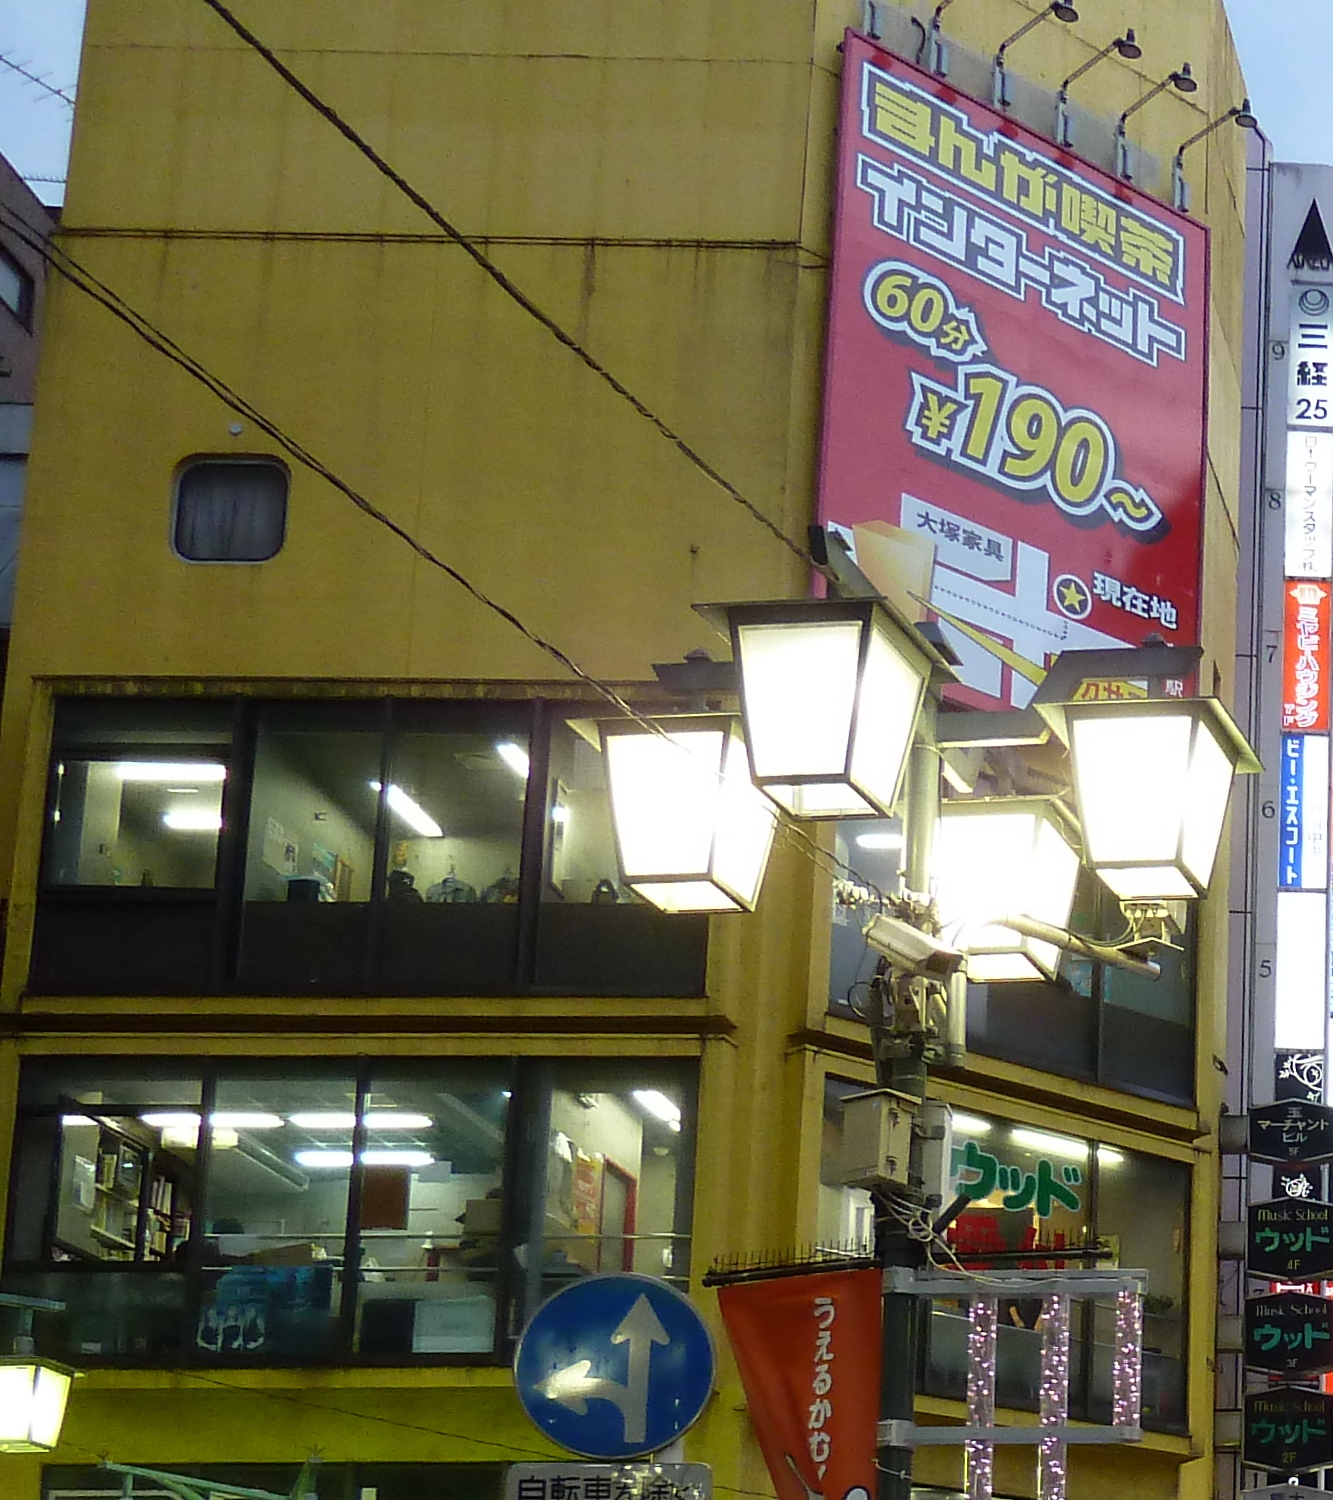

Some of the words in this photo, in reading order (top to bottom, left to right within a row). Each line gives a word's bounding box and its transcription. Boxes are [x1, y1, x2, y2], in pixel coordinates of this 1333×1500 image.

[870, 82, 1182, 294] まんが喫茶
[863, 164, 1184, 364] インターネット
[874, 274, 972, 350] 60分
[1271, 343, 1286, 362] 9
[1297, 322, 1329, 387] 三経
[1295, 398, 1328, 420] 25
[916, 510, 1004, 562] 大塚家具
[1092, 570, 1178, 630] 現在地
[1261, 800, 1277, 820] 6
[1259, 960, 1273, 979] 5
[1257, 1118, 1330, 1131] マーチャント
[949, 1140, 1082, 1218] ウッド
[1257, 1209, 1292, 1222] Music
[1295, 1209, 1329, 1221] School
[1254, 1227, 1330, 1252] ウッド
[1286, 1258, 1301, 1271] 4F
[1255, 1304, 1286, 1317] Music
[1290, 1303, 1328, 1316] School
[1253, 1322, 1330, 1350] ウッド
[1286, 1357, 1299, 1369] 3F
[1251, 1418, 1327, 1444] ウッド
